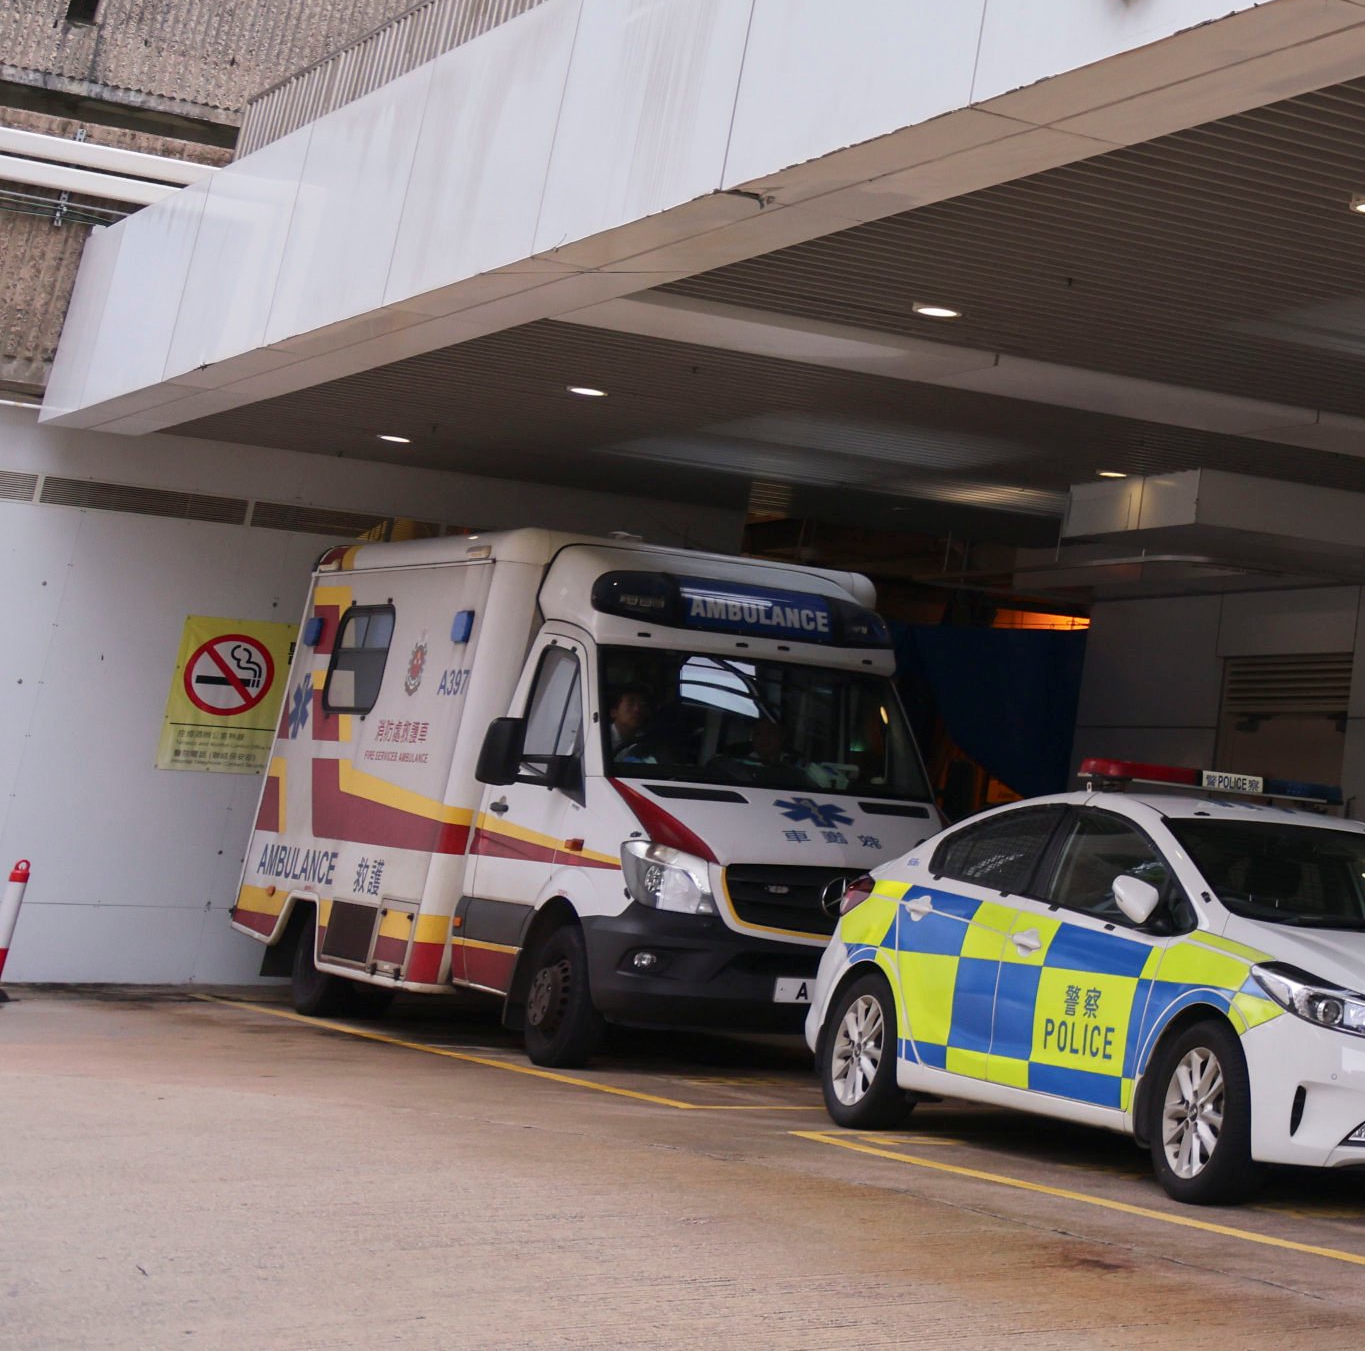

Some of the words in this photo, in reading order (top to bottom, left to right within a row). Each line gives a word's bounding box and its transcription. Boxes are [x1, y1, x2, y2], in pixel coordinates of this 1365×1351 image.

[690, 595, 830, 633] AMBULANCE
[437, 669, 470, 696] A397
[375, 720, 430, 743] 消防處救護車
[364, 750, 376, 761] FIRE
[375, 751, 399, 762] SERVICES
[398, 752, 429, 764] AMBULANCE
[1218, 775, 1247, 791] POLICE
[257, 844, 339, 885] AMBULANCE
[353, 857, 385, 895] 救護
[795, 982, 808, 1000] A
[1064, 985, 1102, 1019] 警察
[1043, 1018, 1115, 1060] POLICE
